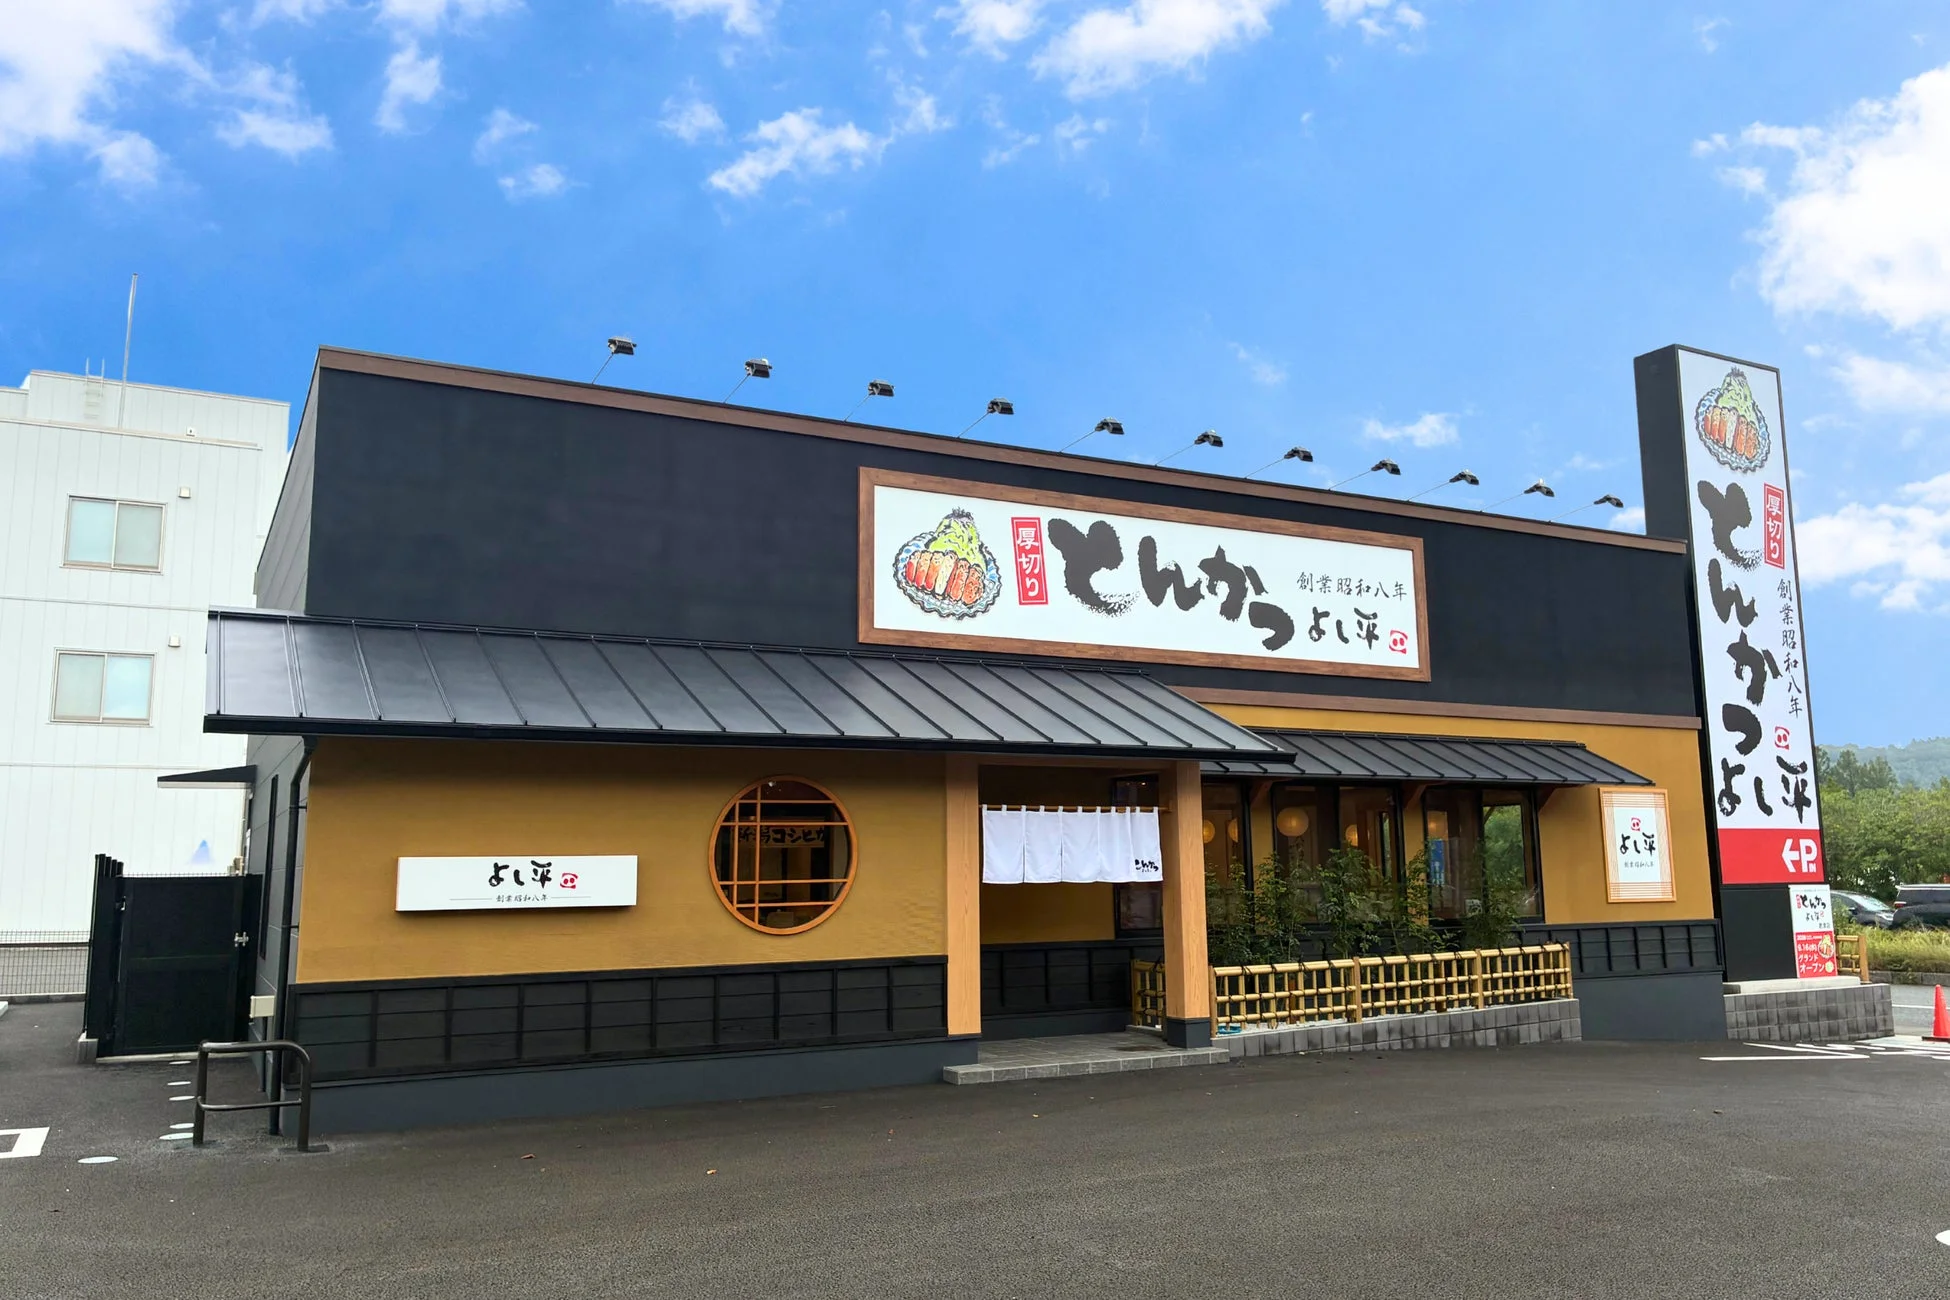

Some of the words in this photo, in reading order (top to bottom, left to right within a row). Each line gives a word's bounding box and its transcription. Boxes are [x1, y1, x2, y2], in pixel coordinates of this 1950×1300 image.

[1766, 495, 1783, 560] 厚切り
[1017, 527, 1041, 598] 厚切り
[1047, 518, 1295, 651] とんかつ
[1296, 571, 1408, 602] 創業昭和八年
[1308, 606, 1380, 651] よし平
[1697, 480, 1783, 756] とんかつ
[1776, 578, 1804, 718] 創業昭和八年
[1718, 755, 1812, 824] よし平
[1619, 832, 1656, 857] よし平
[488, 859, 553, 890] よし平
[1800, 894, 1827, 909] とんかつ
[1799, 962, 1825, 973] オープン
